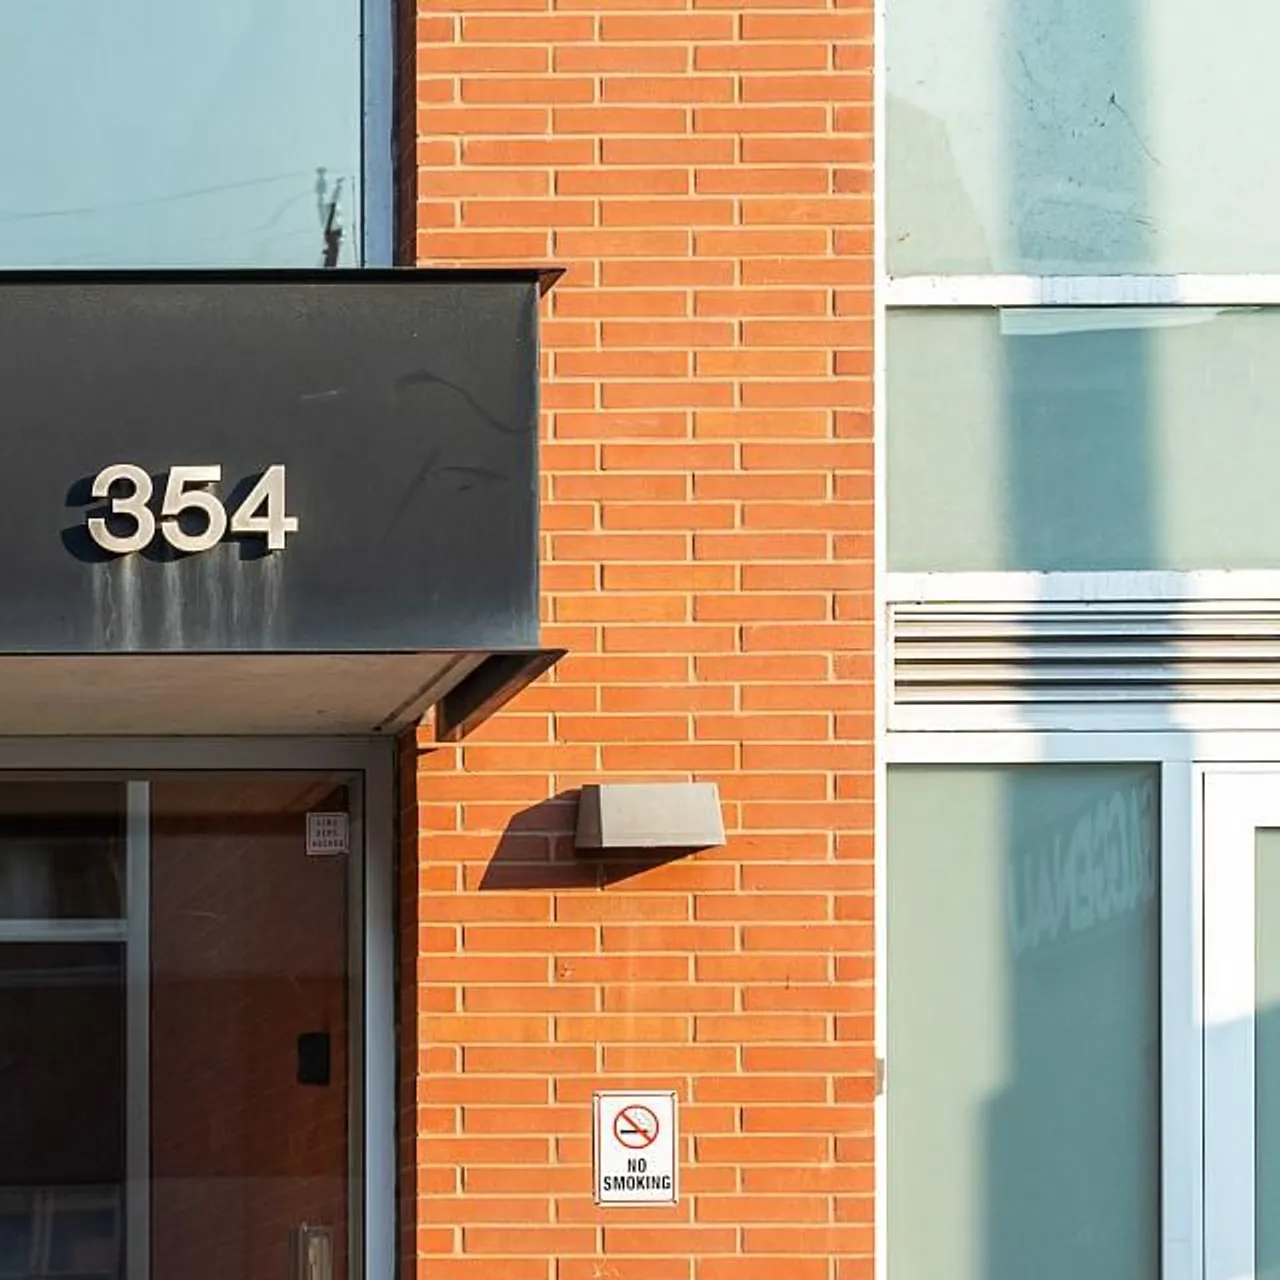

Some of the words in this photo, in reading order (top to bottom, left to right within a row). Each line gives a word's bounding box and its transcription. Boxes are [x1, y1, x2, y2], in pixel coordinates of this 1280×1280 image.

[88, 463, 299, 553] 354
[627, 1157, 647, 1173] NO
[603, 1175, 672, 1192] SMOKING
